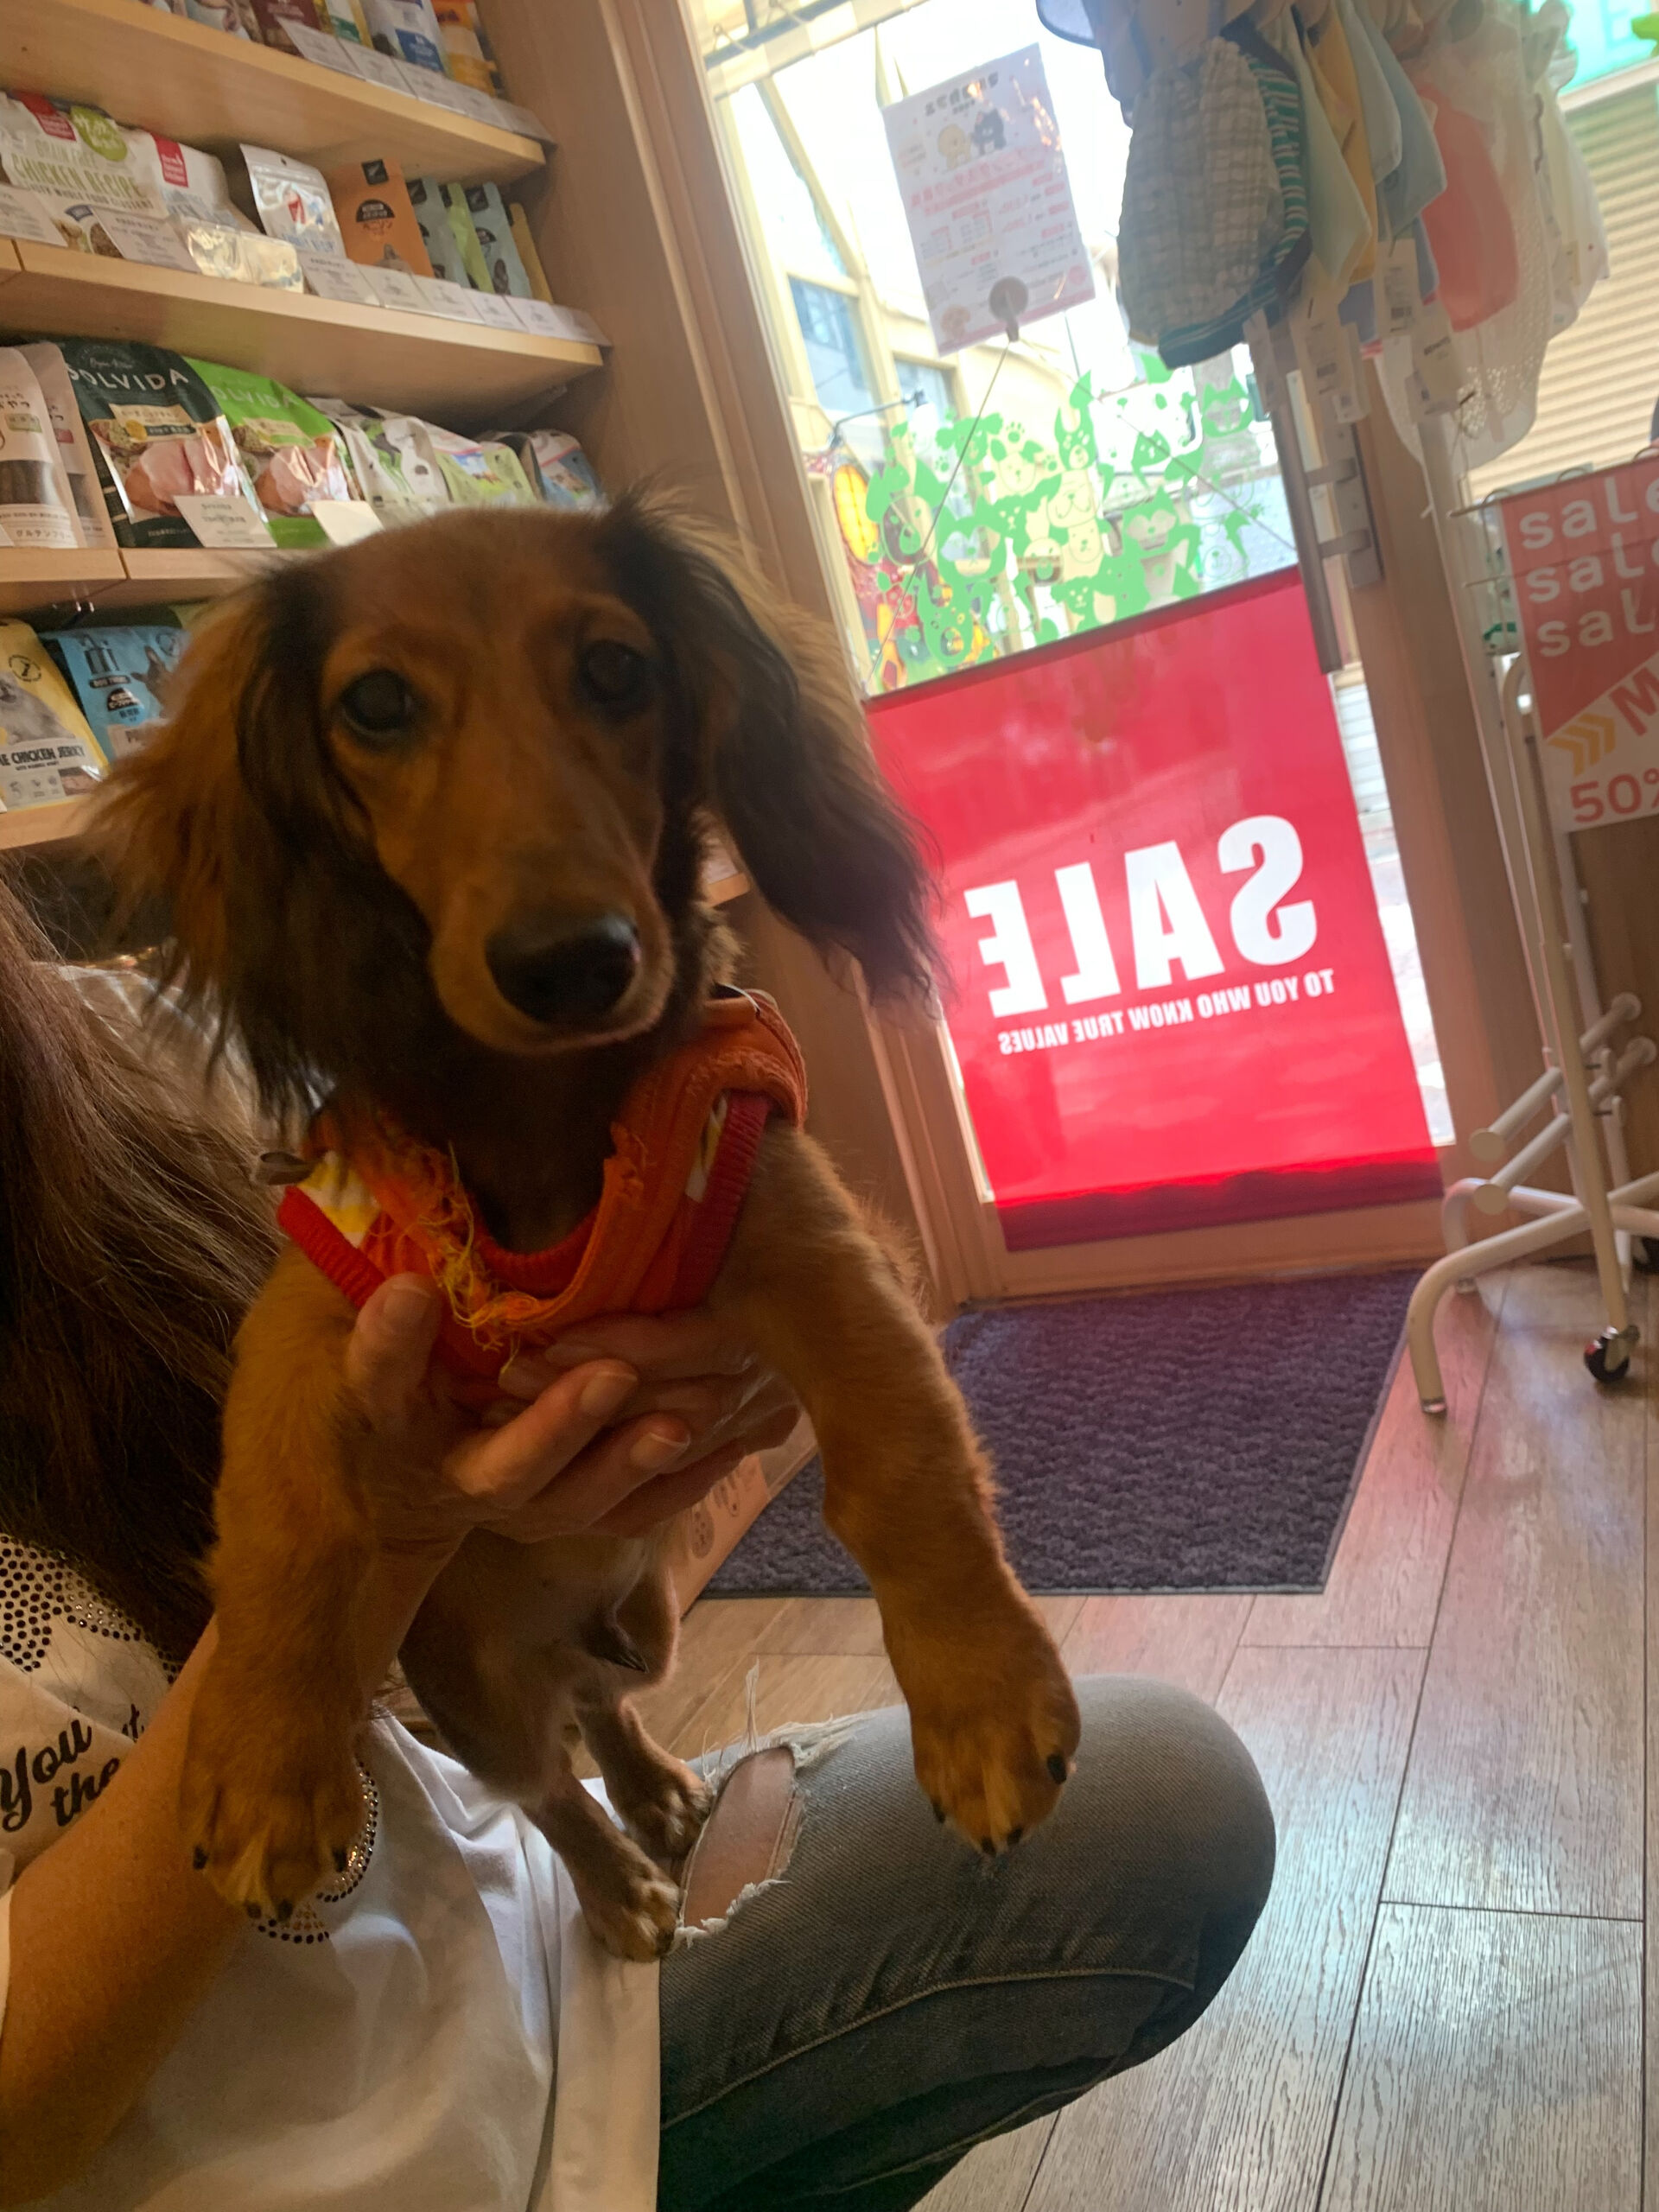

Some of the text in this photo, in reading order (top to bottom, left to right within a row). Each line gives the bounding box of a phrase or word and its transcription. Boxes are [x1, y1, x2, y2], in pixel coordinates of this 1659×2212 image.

[11, 152, 147, 199] CHICKEN RECIPE
[65, 364, 188, 390] SOLVIDA
[213, 386, 300, 410] OLVIDA
[1525, 532, 1659, 602] sal
[11, 747, 56, 765] CHICKEN
[57, 746, 86, 759] JERKY
